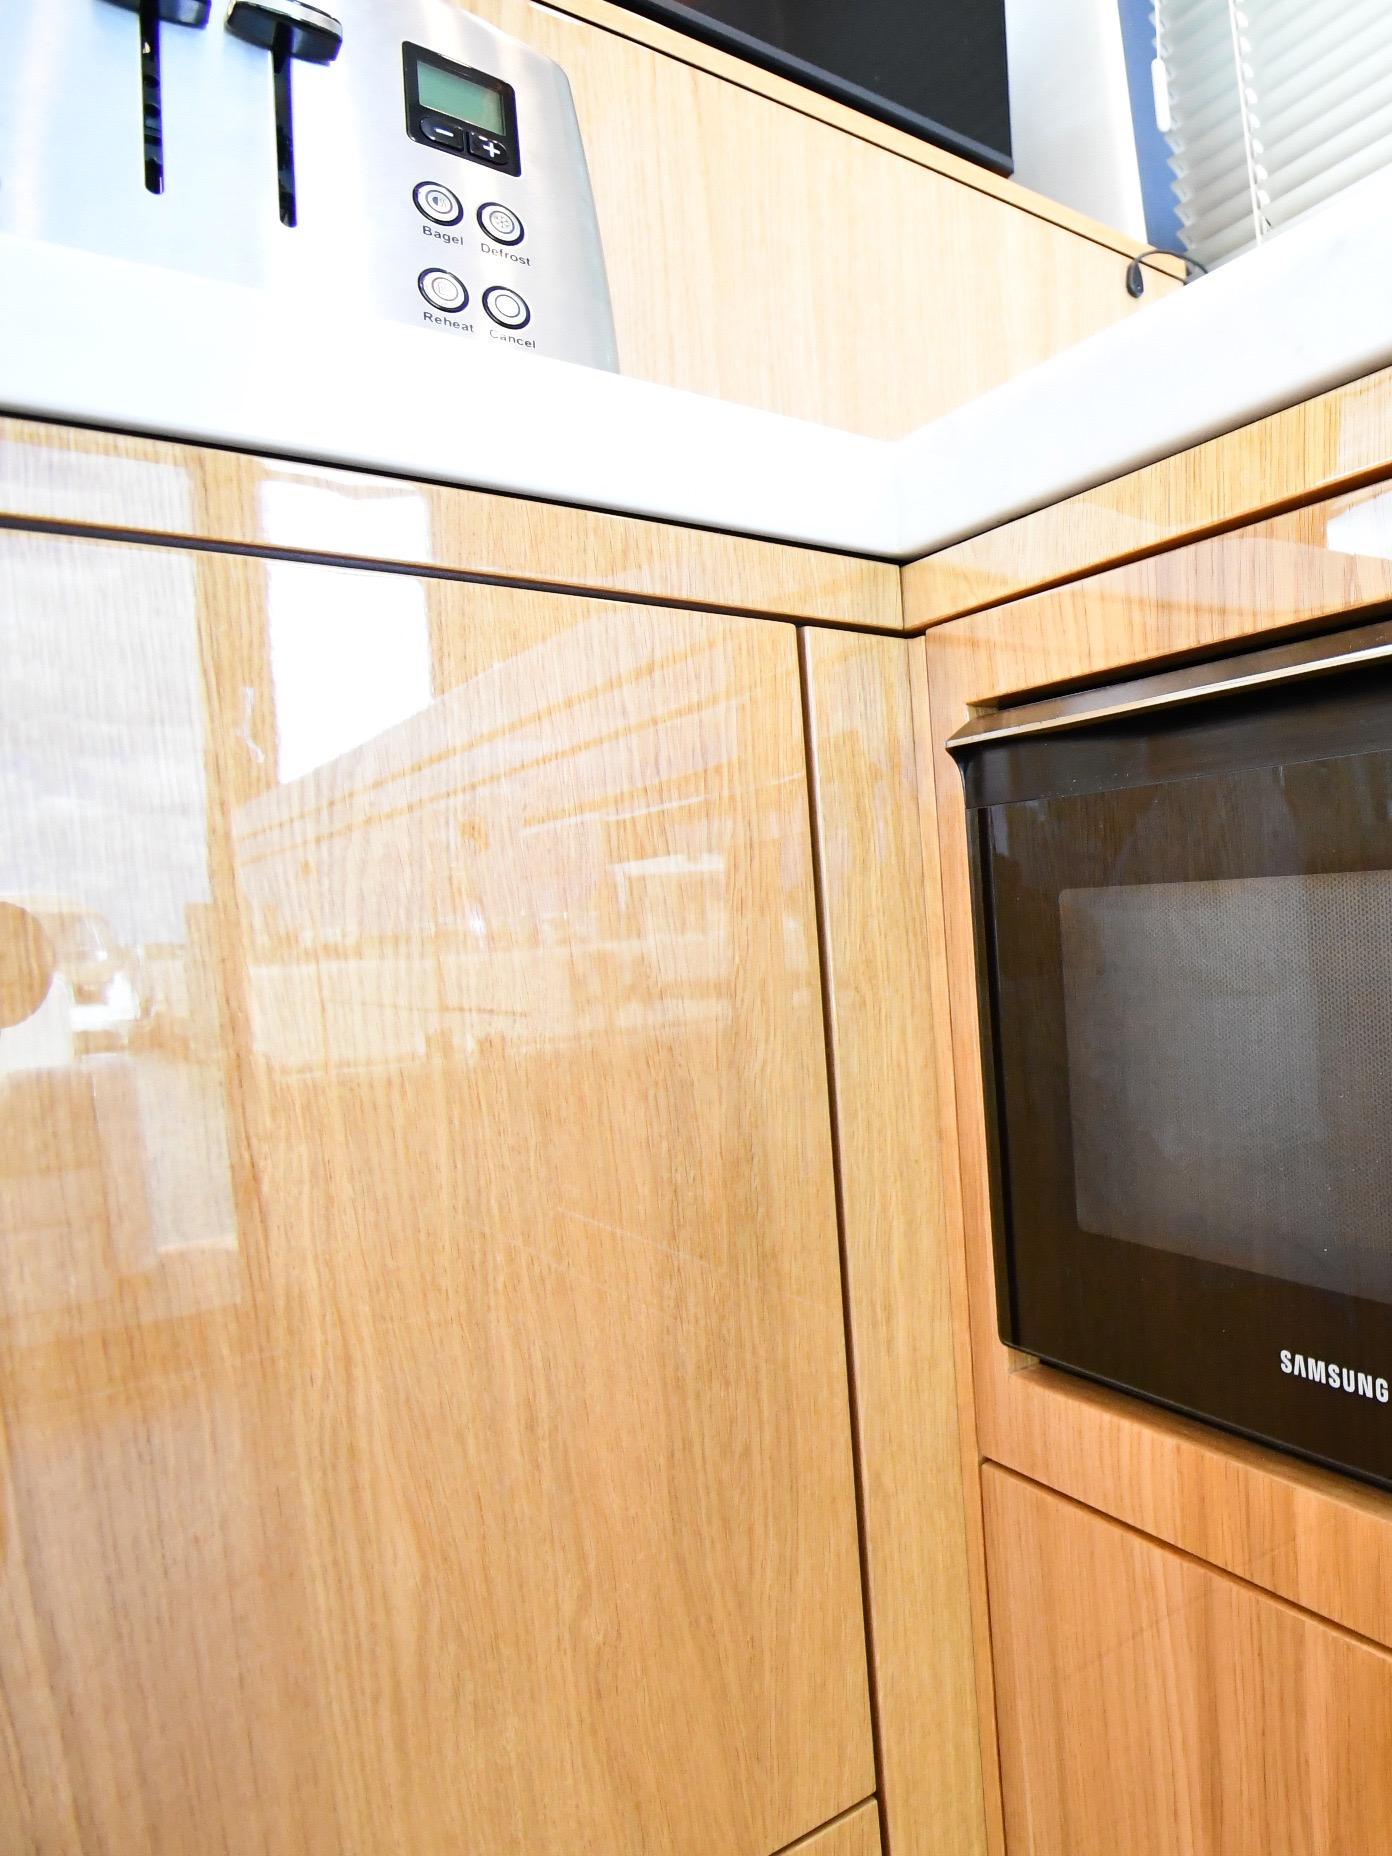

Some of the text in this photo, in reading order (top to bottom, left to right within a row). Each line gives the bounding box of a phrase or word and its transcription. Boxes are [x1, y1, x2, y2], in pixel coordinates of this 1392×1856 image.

[422, 225, 464, 246] Bagel
[480, 243, 531, 267] Defrost
[423, 311, 474, 333] Reheat
[489, 329, 536, 349] Cancel
[1280, 1350, 1389, 1403] SAMSUNG
